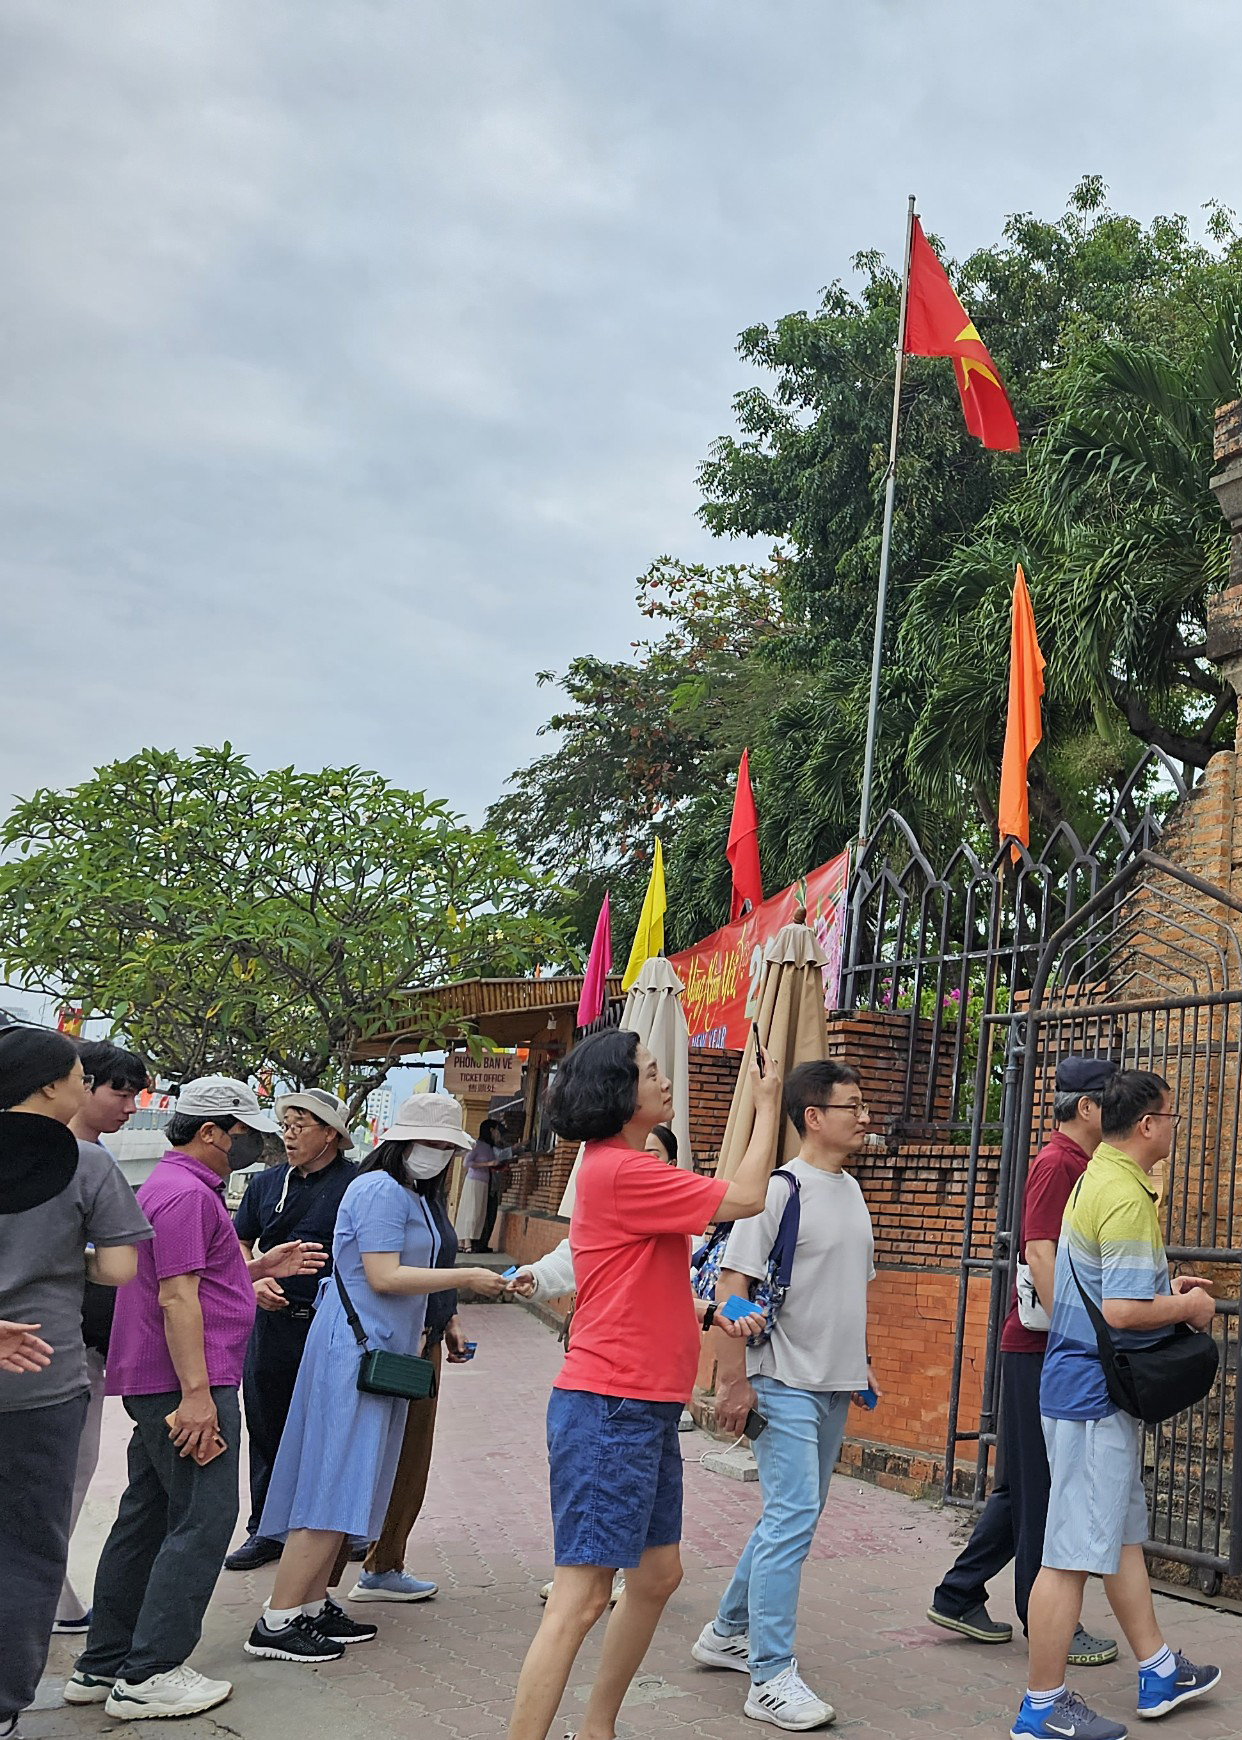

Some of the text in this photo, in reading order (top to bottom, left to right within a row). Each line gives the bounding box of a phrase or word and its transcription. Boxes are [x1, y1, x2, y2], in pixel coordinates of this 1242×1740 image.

[691, 1024, 727, 1049] NEW YEAR
[502, 1054, 513, 1070] VÉ
[460, 1073, 506, 1083] TICKET OFFICE
[1067, 1653, 1103, 1663] crocs
